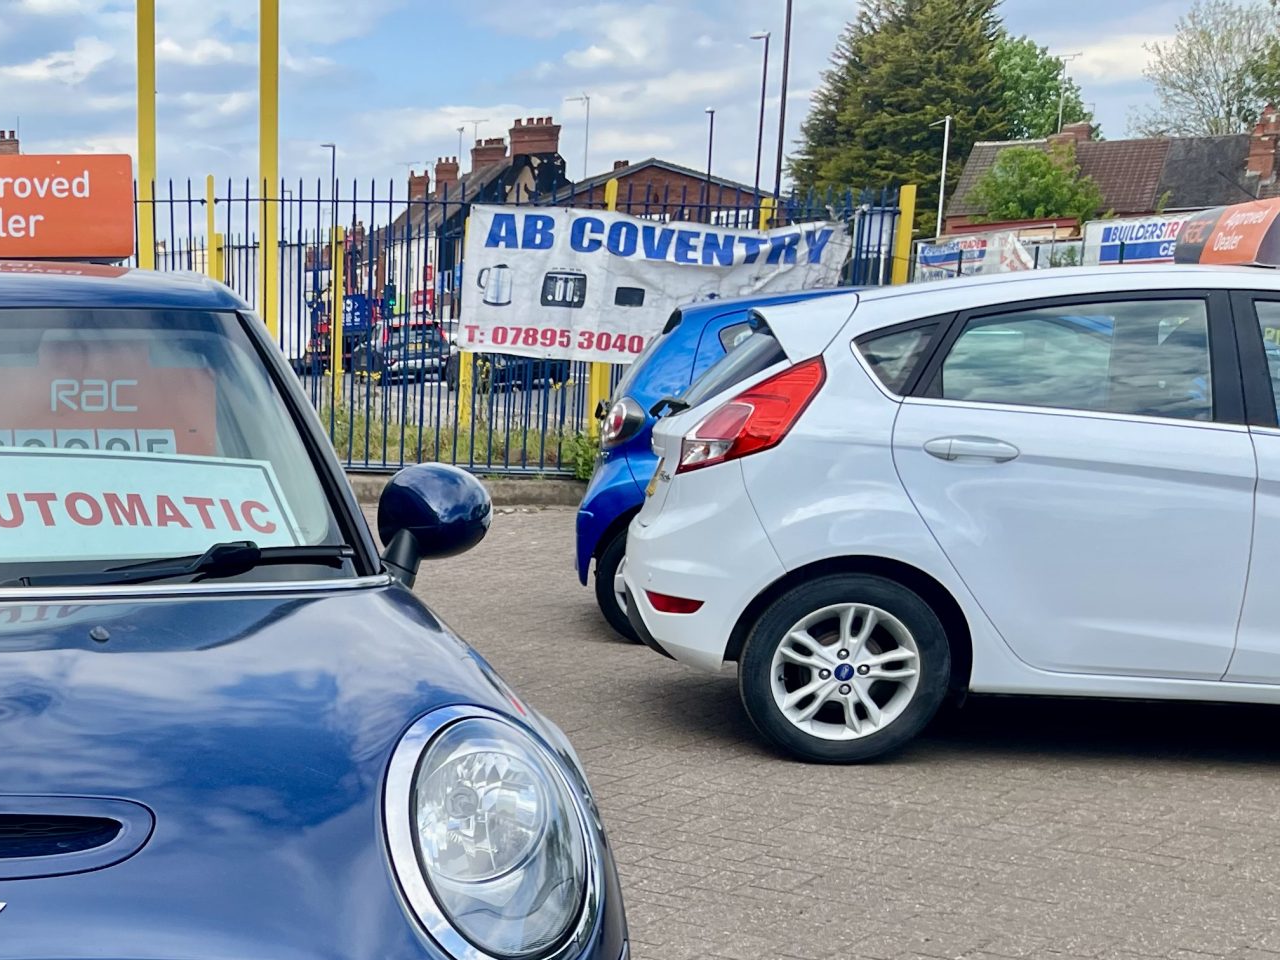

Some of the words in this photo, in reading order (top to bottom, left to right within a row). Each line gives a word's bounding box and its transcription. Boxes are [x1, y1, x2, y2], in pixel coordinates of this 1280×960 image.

[485, 213, 556, 250] AB
[569, 216, 834, 266] COVENTRY
[1212, 231, 1244, 252] Dealer
[465, 325, 485, 344] T:
[491, 325, 571, 348] 07895
[577, 330, 647, 355] 3040
